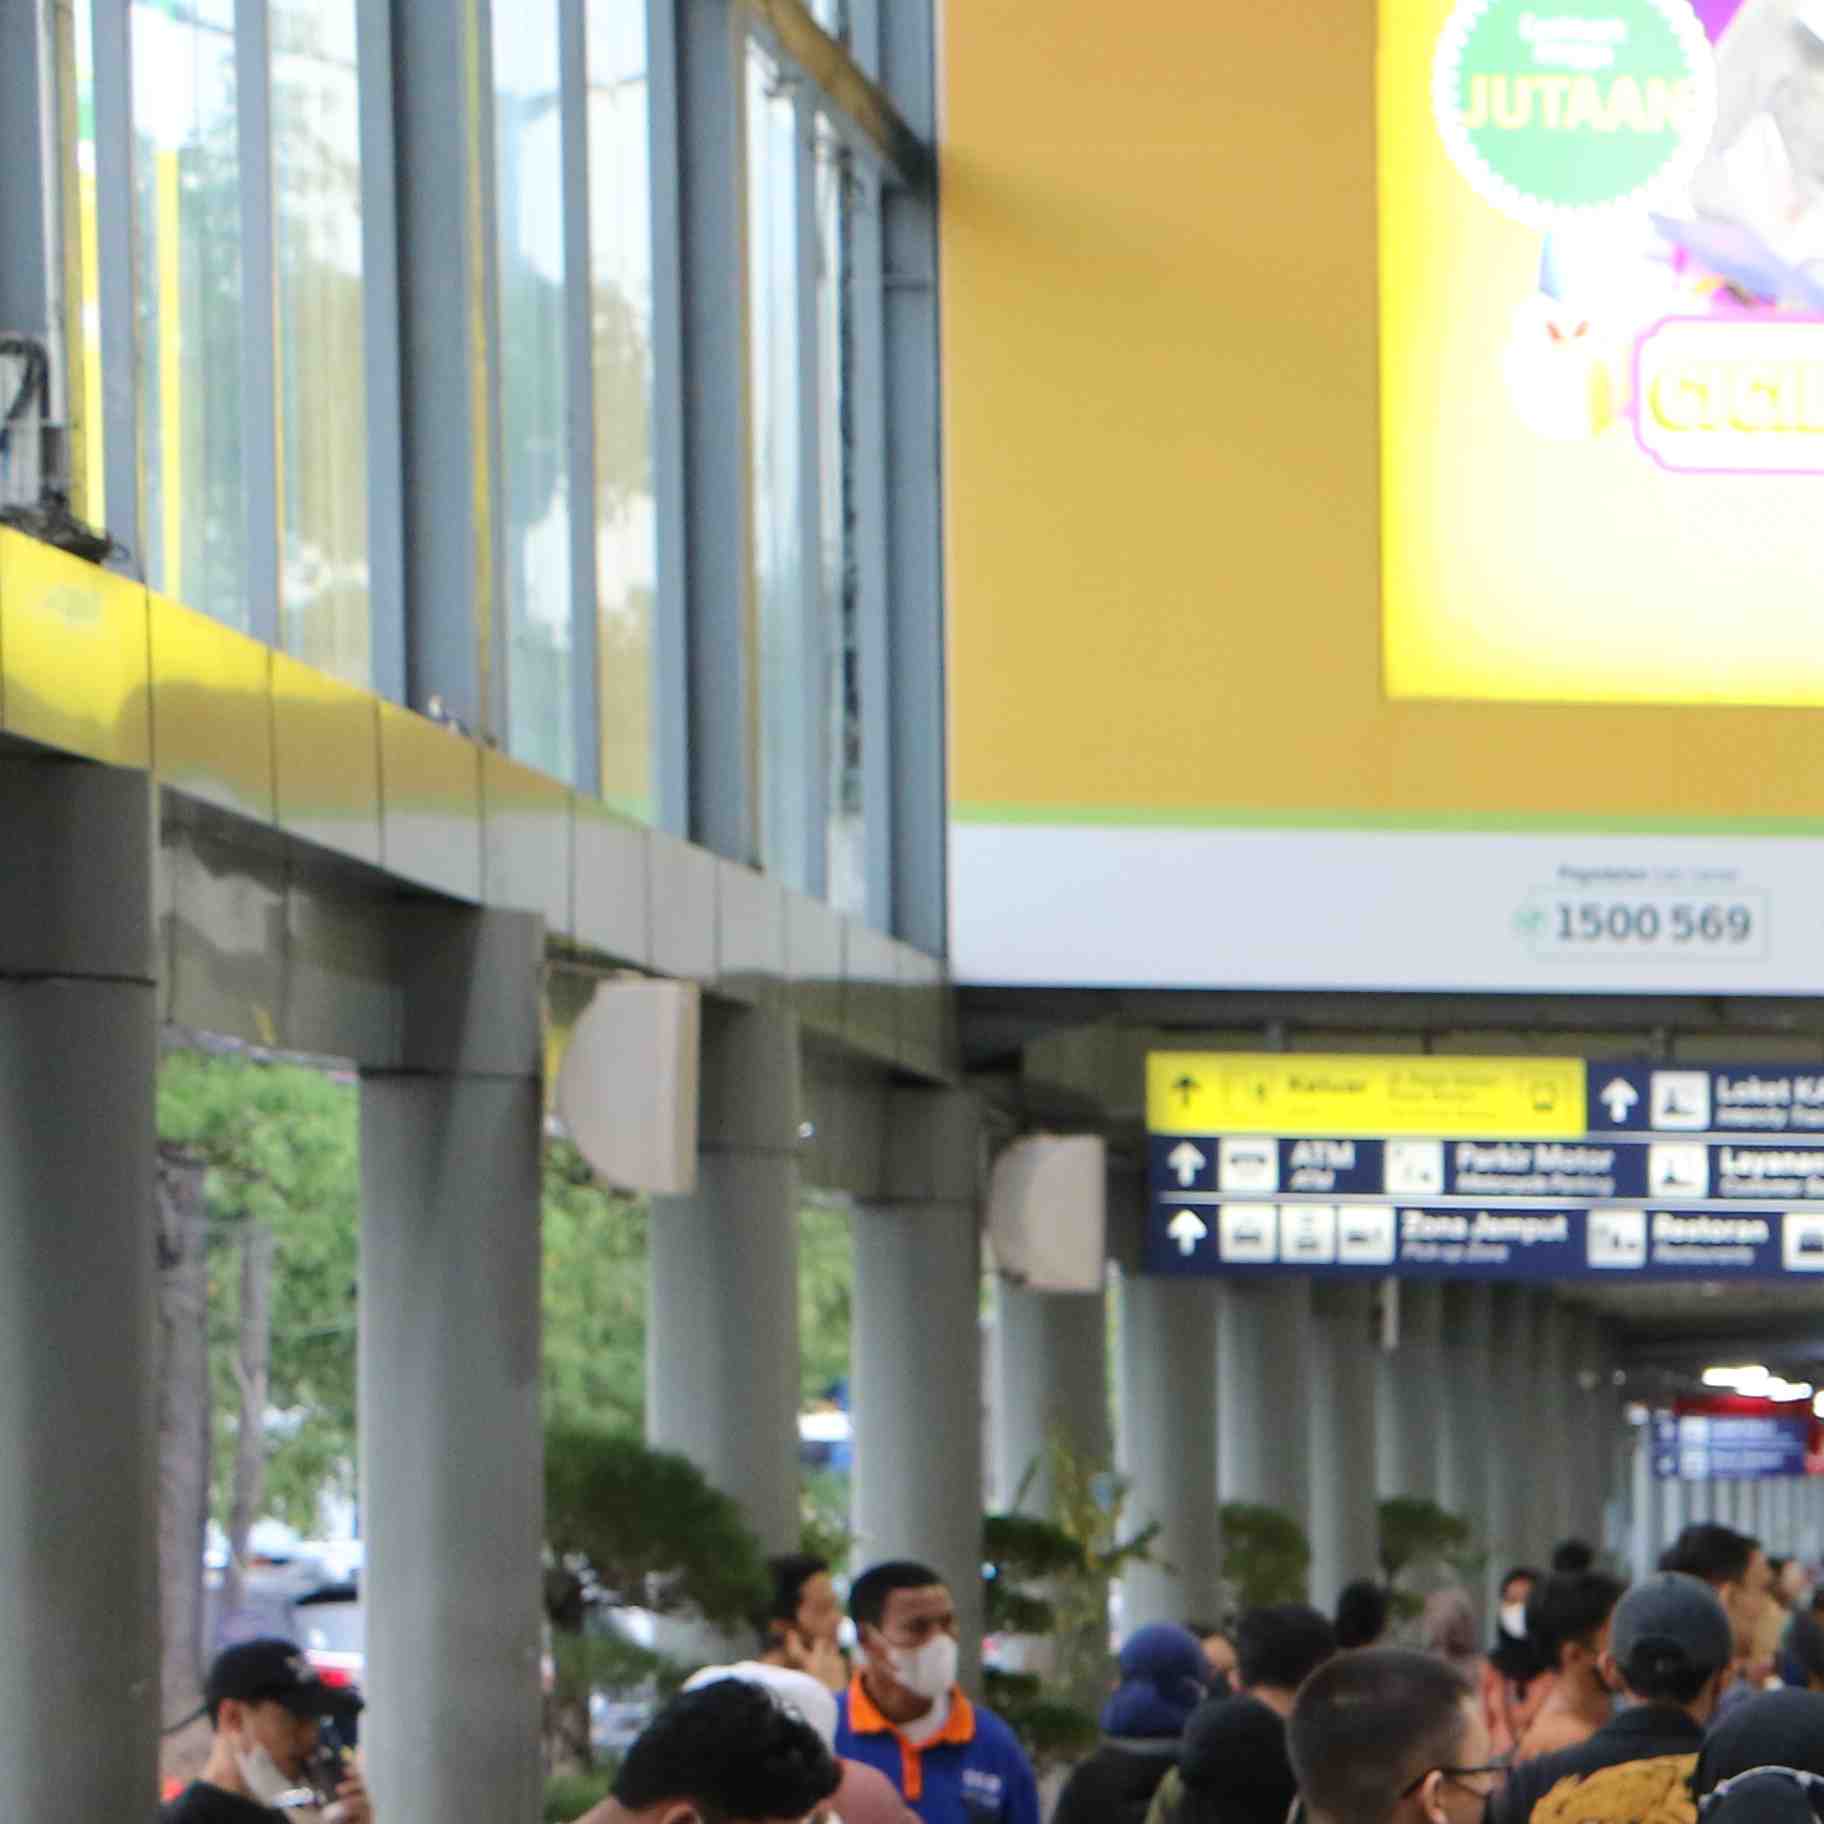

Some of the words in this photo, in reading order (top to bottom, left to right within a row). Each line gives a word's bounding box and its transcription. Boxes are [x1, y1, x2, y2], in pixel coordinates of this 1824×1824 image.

[1556, 903, 1662, 943] 1500
[1671, 904, 1754, 943] 569
[1290, 1140, 1357, 1170] ATM
